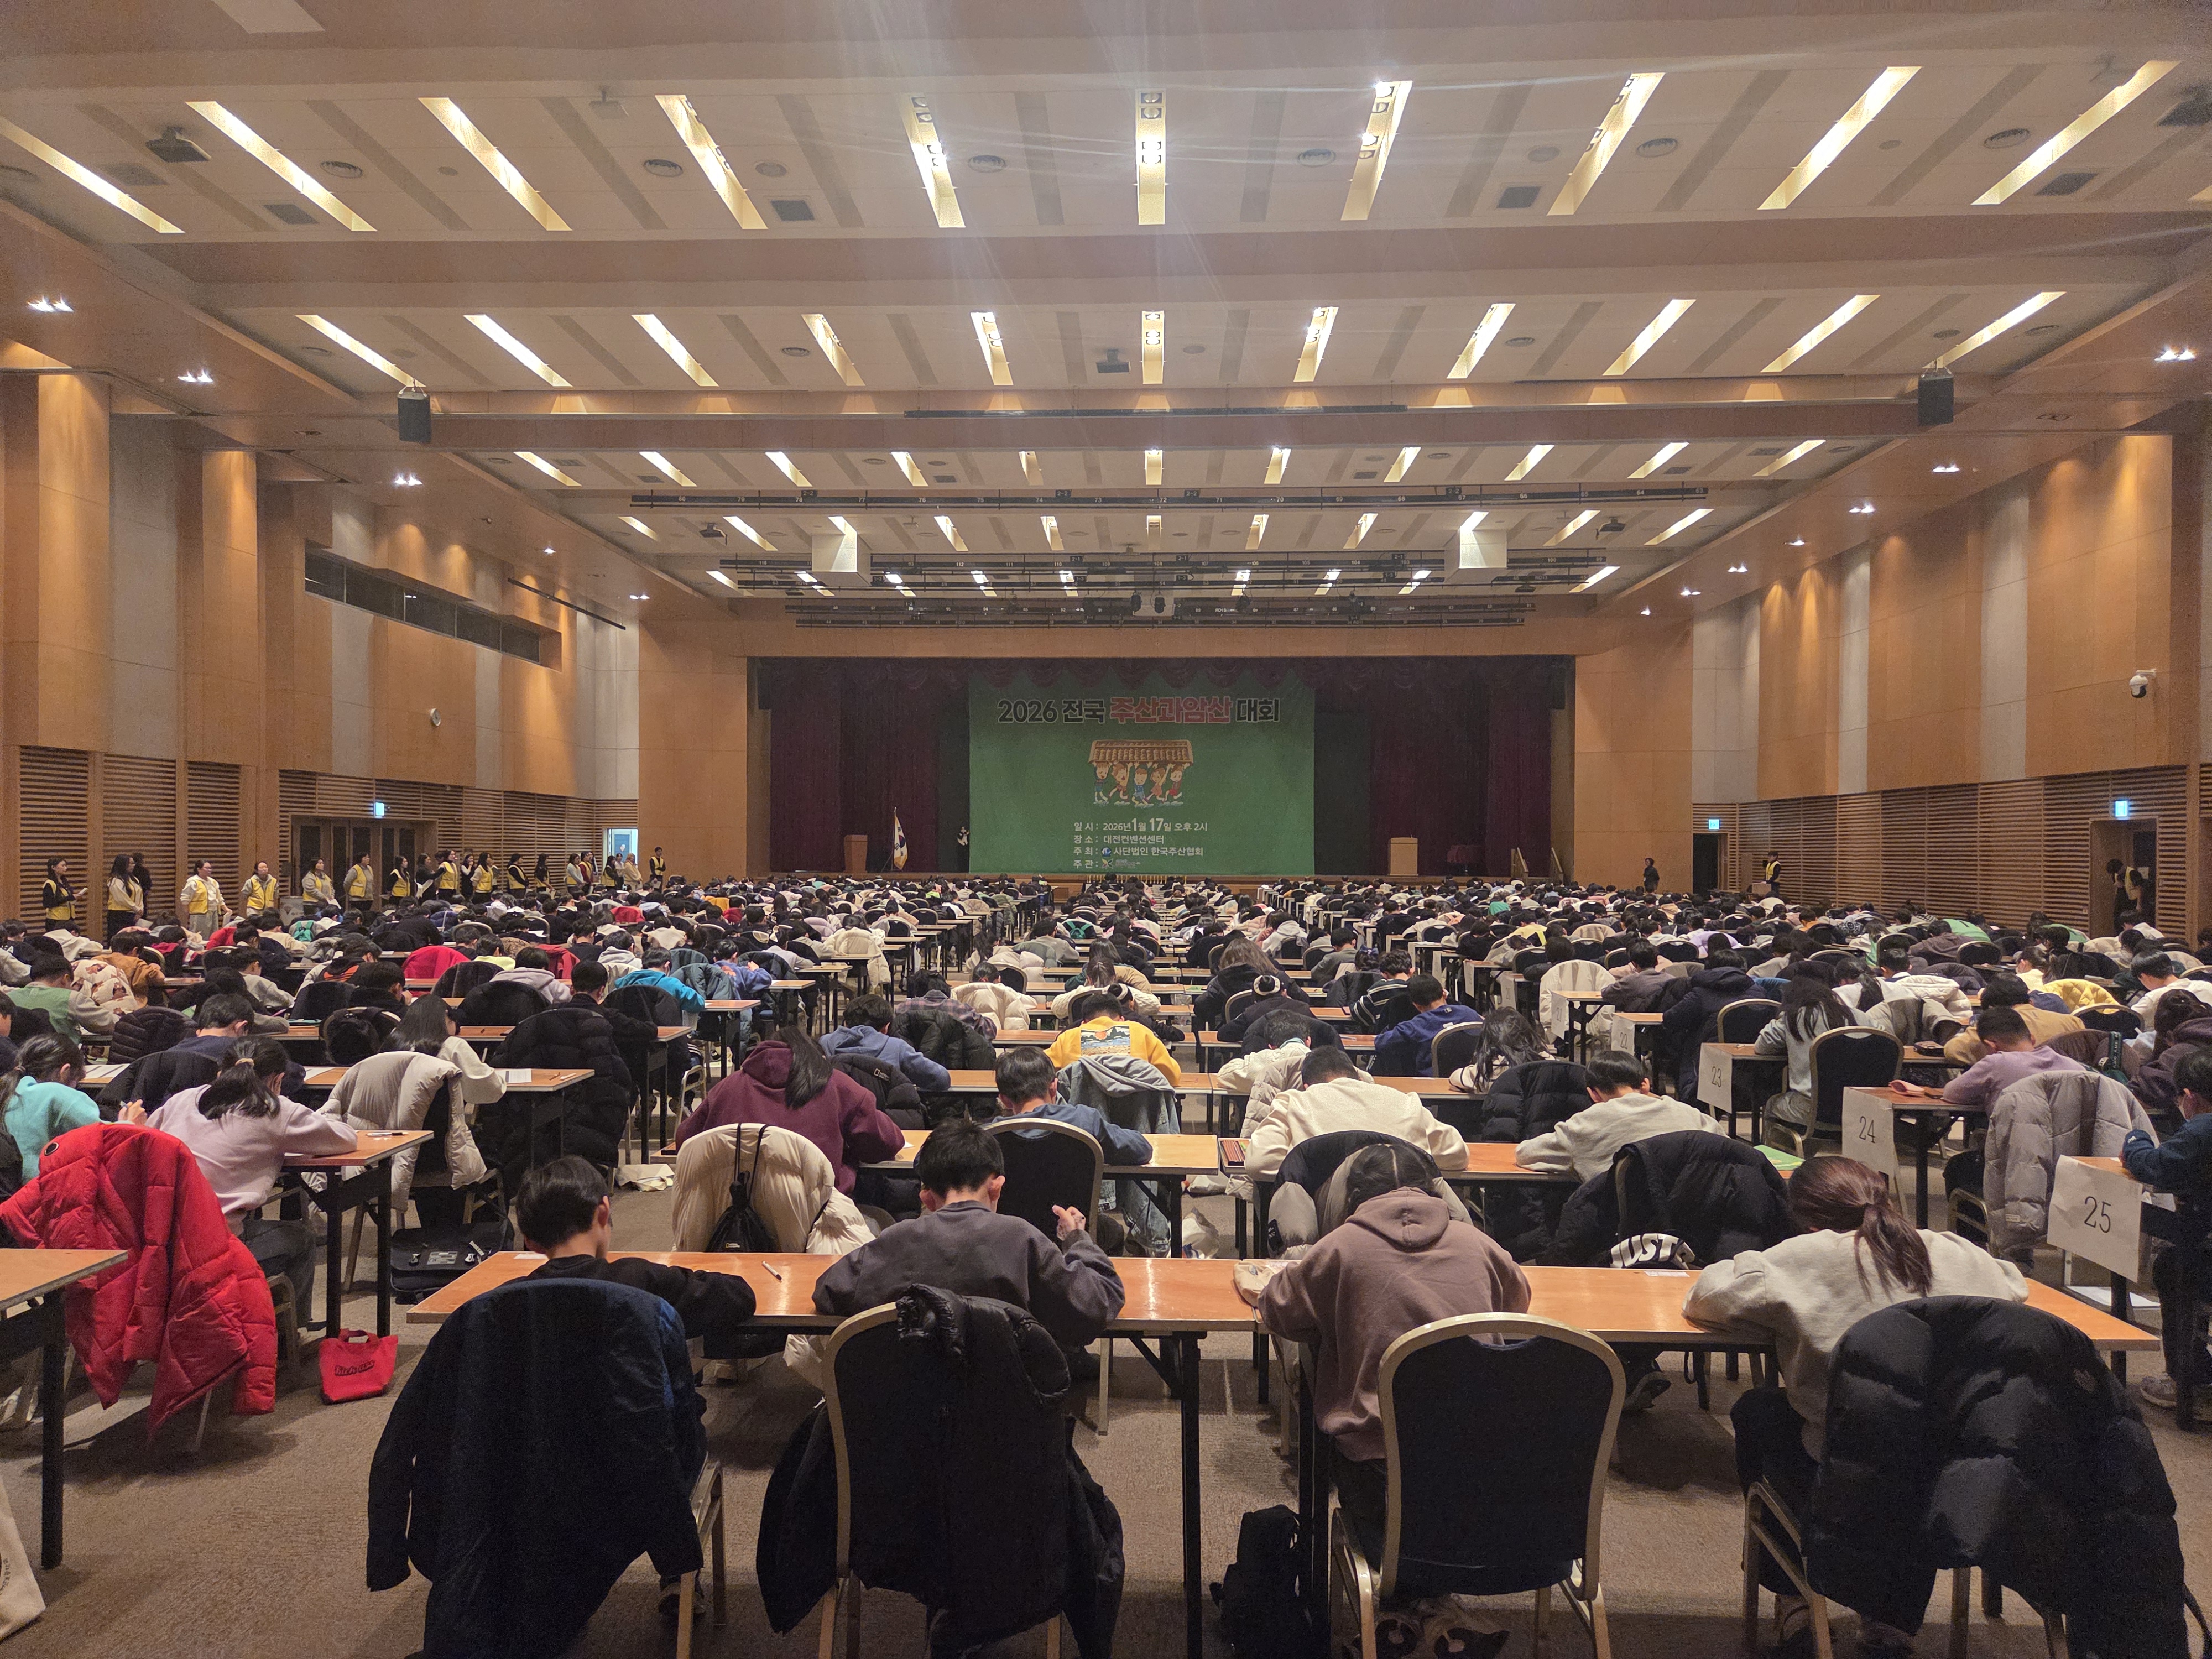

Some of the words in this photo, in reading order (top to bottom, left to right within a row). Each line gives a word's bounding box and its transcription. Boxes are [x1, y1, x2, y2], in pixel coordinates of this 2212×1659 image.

[997, 699, 1058, 724] 2026
[1062, 698, 1105, 724] 전국
[1110, 696, 1233, 724] 주산과암산
[1235, 698, 1280, 723] 대회
[1149, 818, 1171, 832] 17일
[1174, 822, 1192, 832] 오후
[1194, 822, 1207, 832] 2시
[1103, 835, 1164, 844] 대전컨벤션센터
[1113, 847, 1149, 856] 사단법인
[1151, 847, 1203, 857] 한국주산협회
[1556, 1006, 1563, 1022] 21
[1620, 1032, 1628, 1050] 22
[1711, 1066, 1723, 1088] 23
[1859, 1115, 1876, 1144] 24
[2084, 1196, 2112, 1233] 25
